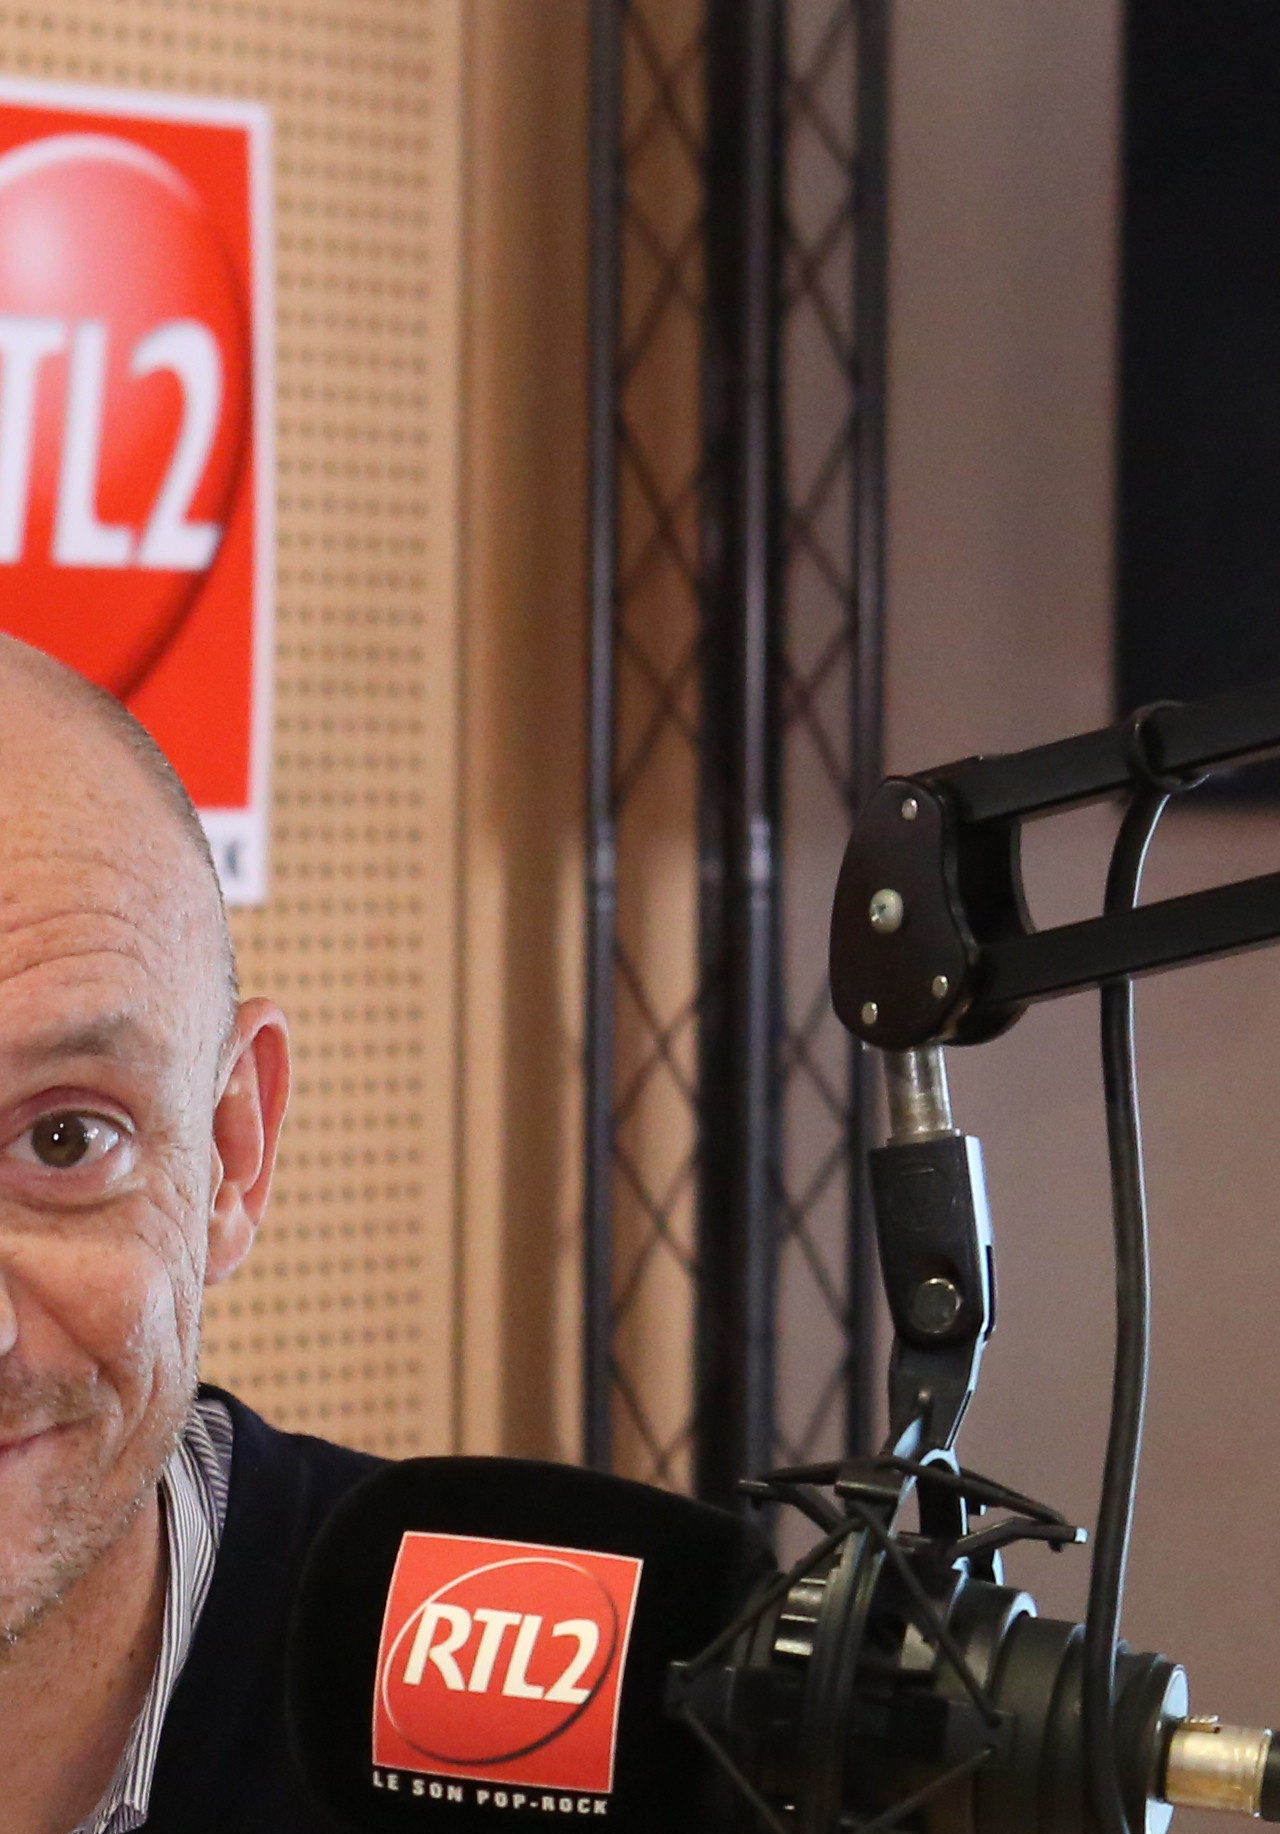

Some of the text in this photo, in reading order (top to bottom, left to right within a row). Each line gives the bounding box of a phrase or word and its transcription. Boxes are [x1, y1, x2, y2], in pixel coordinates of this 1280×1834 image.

[402, 1601, 600, 1705] RTL2
[372, 1770, 608, 1816] LE SON POP-ROCK
